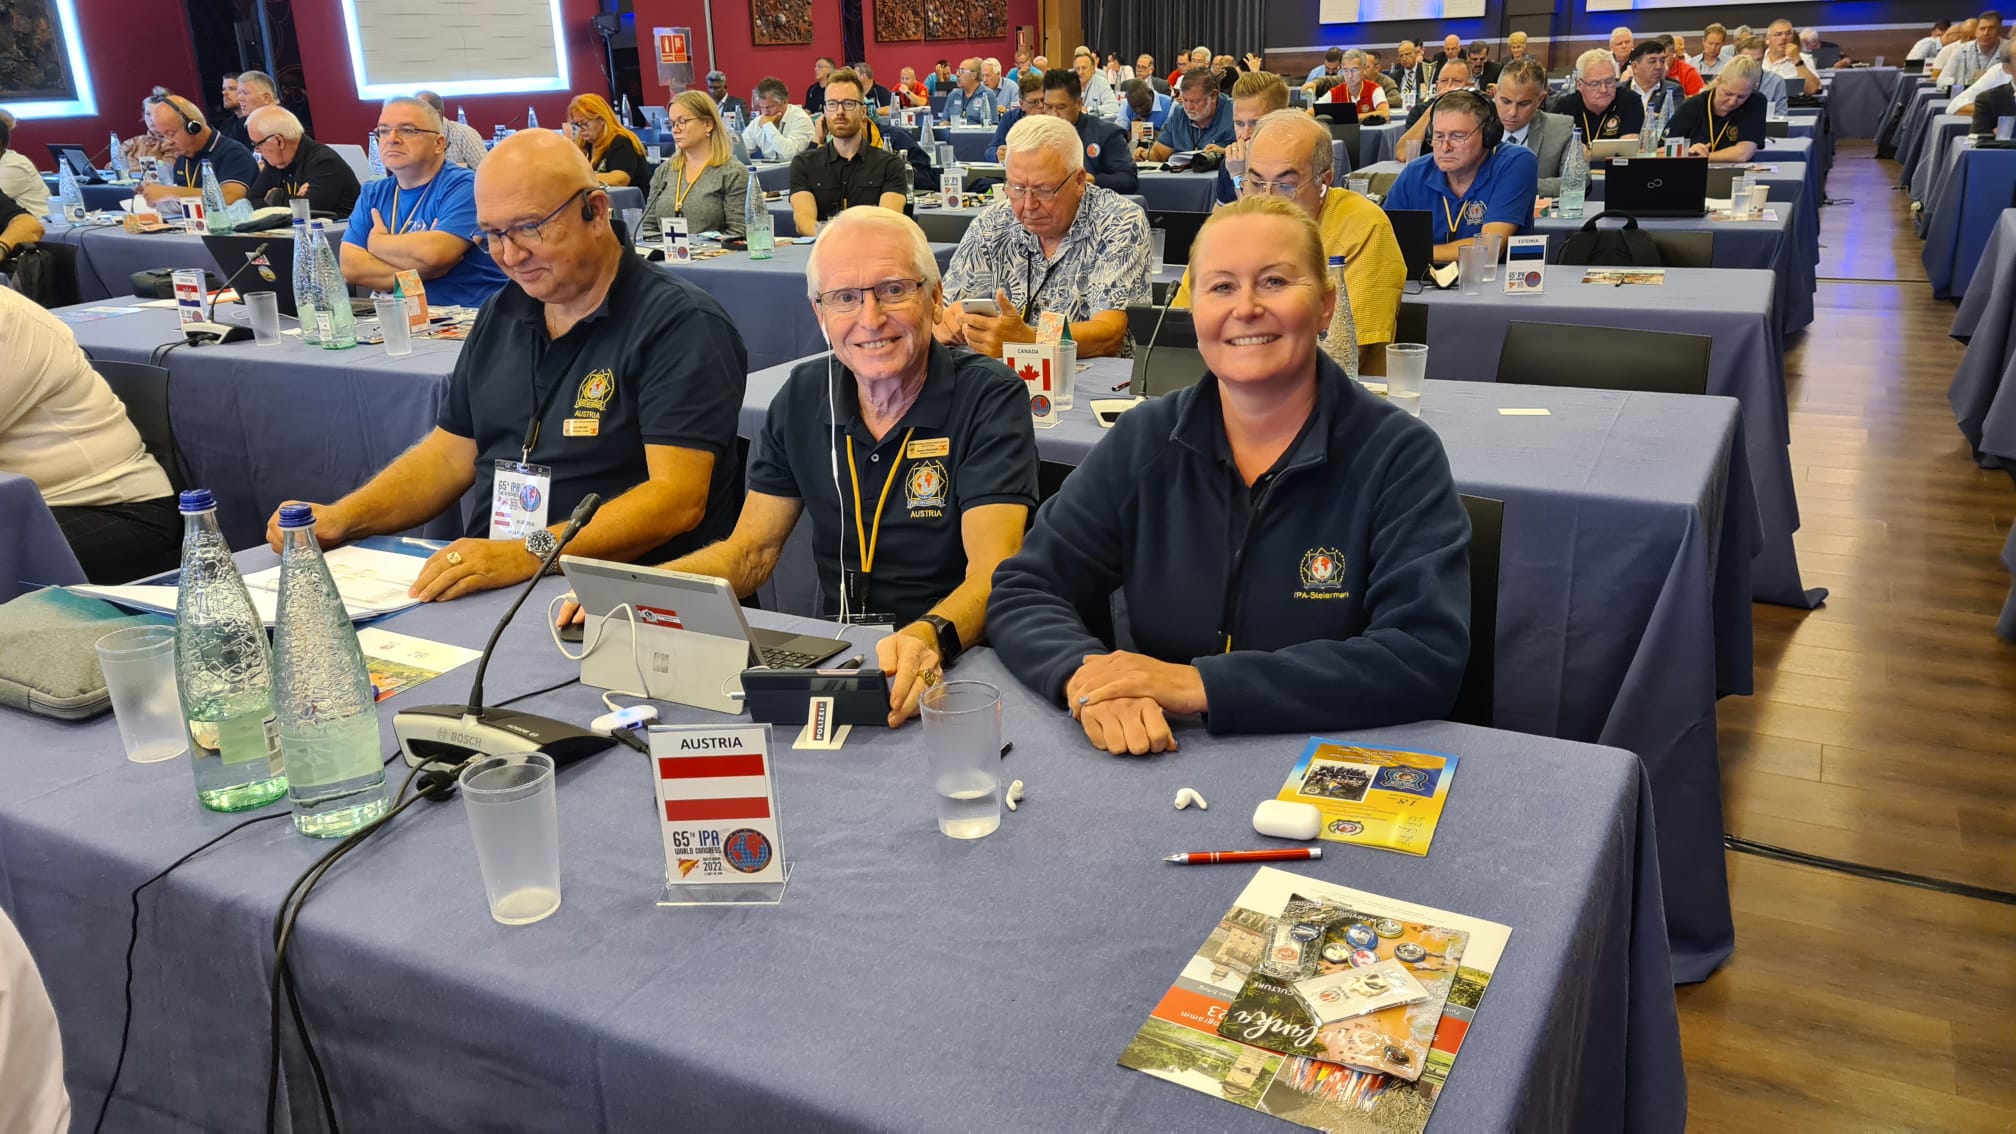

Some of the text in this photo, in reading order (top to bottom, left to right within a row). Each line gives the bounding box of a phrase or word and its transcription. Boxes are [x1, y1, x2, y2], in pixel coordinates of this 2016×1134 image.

[574, 409, 600, 419] AUSTRIA
[910, 509, 942, 518] AUSTRIA
[816, 707, 825, 740] POLIZEI
[450, 731, 482, 748] BOSCH
[680, 736, 743, 750] AUSTRIA
[698, 830, 720, 847] IPA
[695, 846, 721, 855] CONGRESS
[703, 862, 722, 872] 2022
[1253, 980, 1295, 996] CULTURE
[1181, 1009, 1220, 1026] ogramm
[1207, 1005, 1229, 1020] 23
